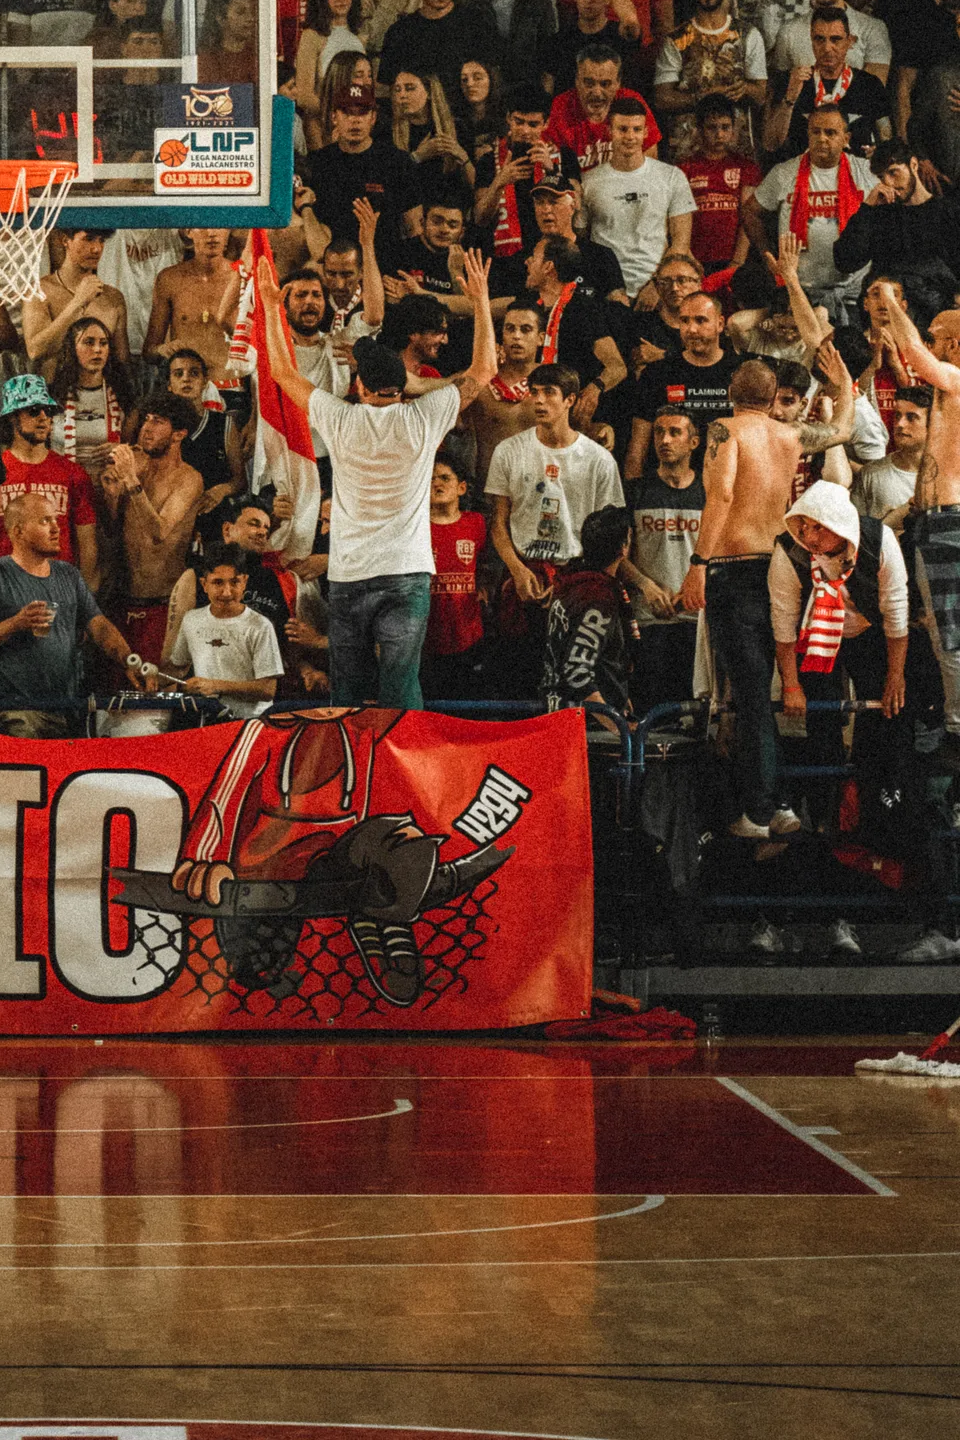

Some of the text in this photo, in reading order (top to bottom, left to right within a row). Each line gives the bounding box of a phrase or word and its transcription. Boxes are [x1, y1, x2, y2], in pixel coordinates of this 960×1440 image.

[190, 131, 255, 153] LNP
[190, 161, 255, 169] PALLACANESTRO
[163, 173, 251, 185] OLD WILD WEST
[687, 388, 727, 396] FLAMINIO
[1, 482, 69, 494] URVA BASKET
[641, 514, 700, 533] Reebo
